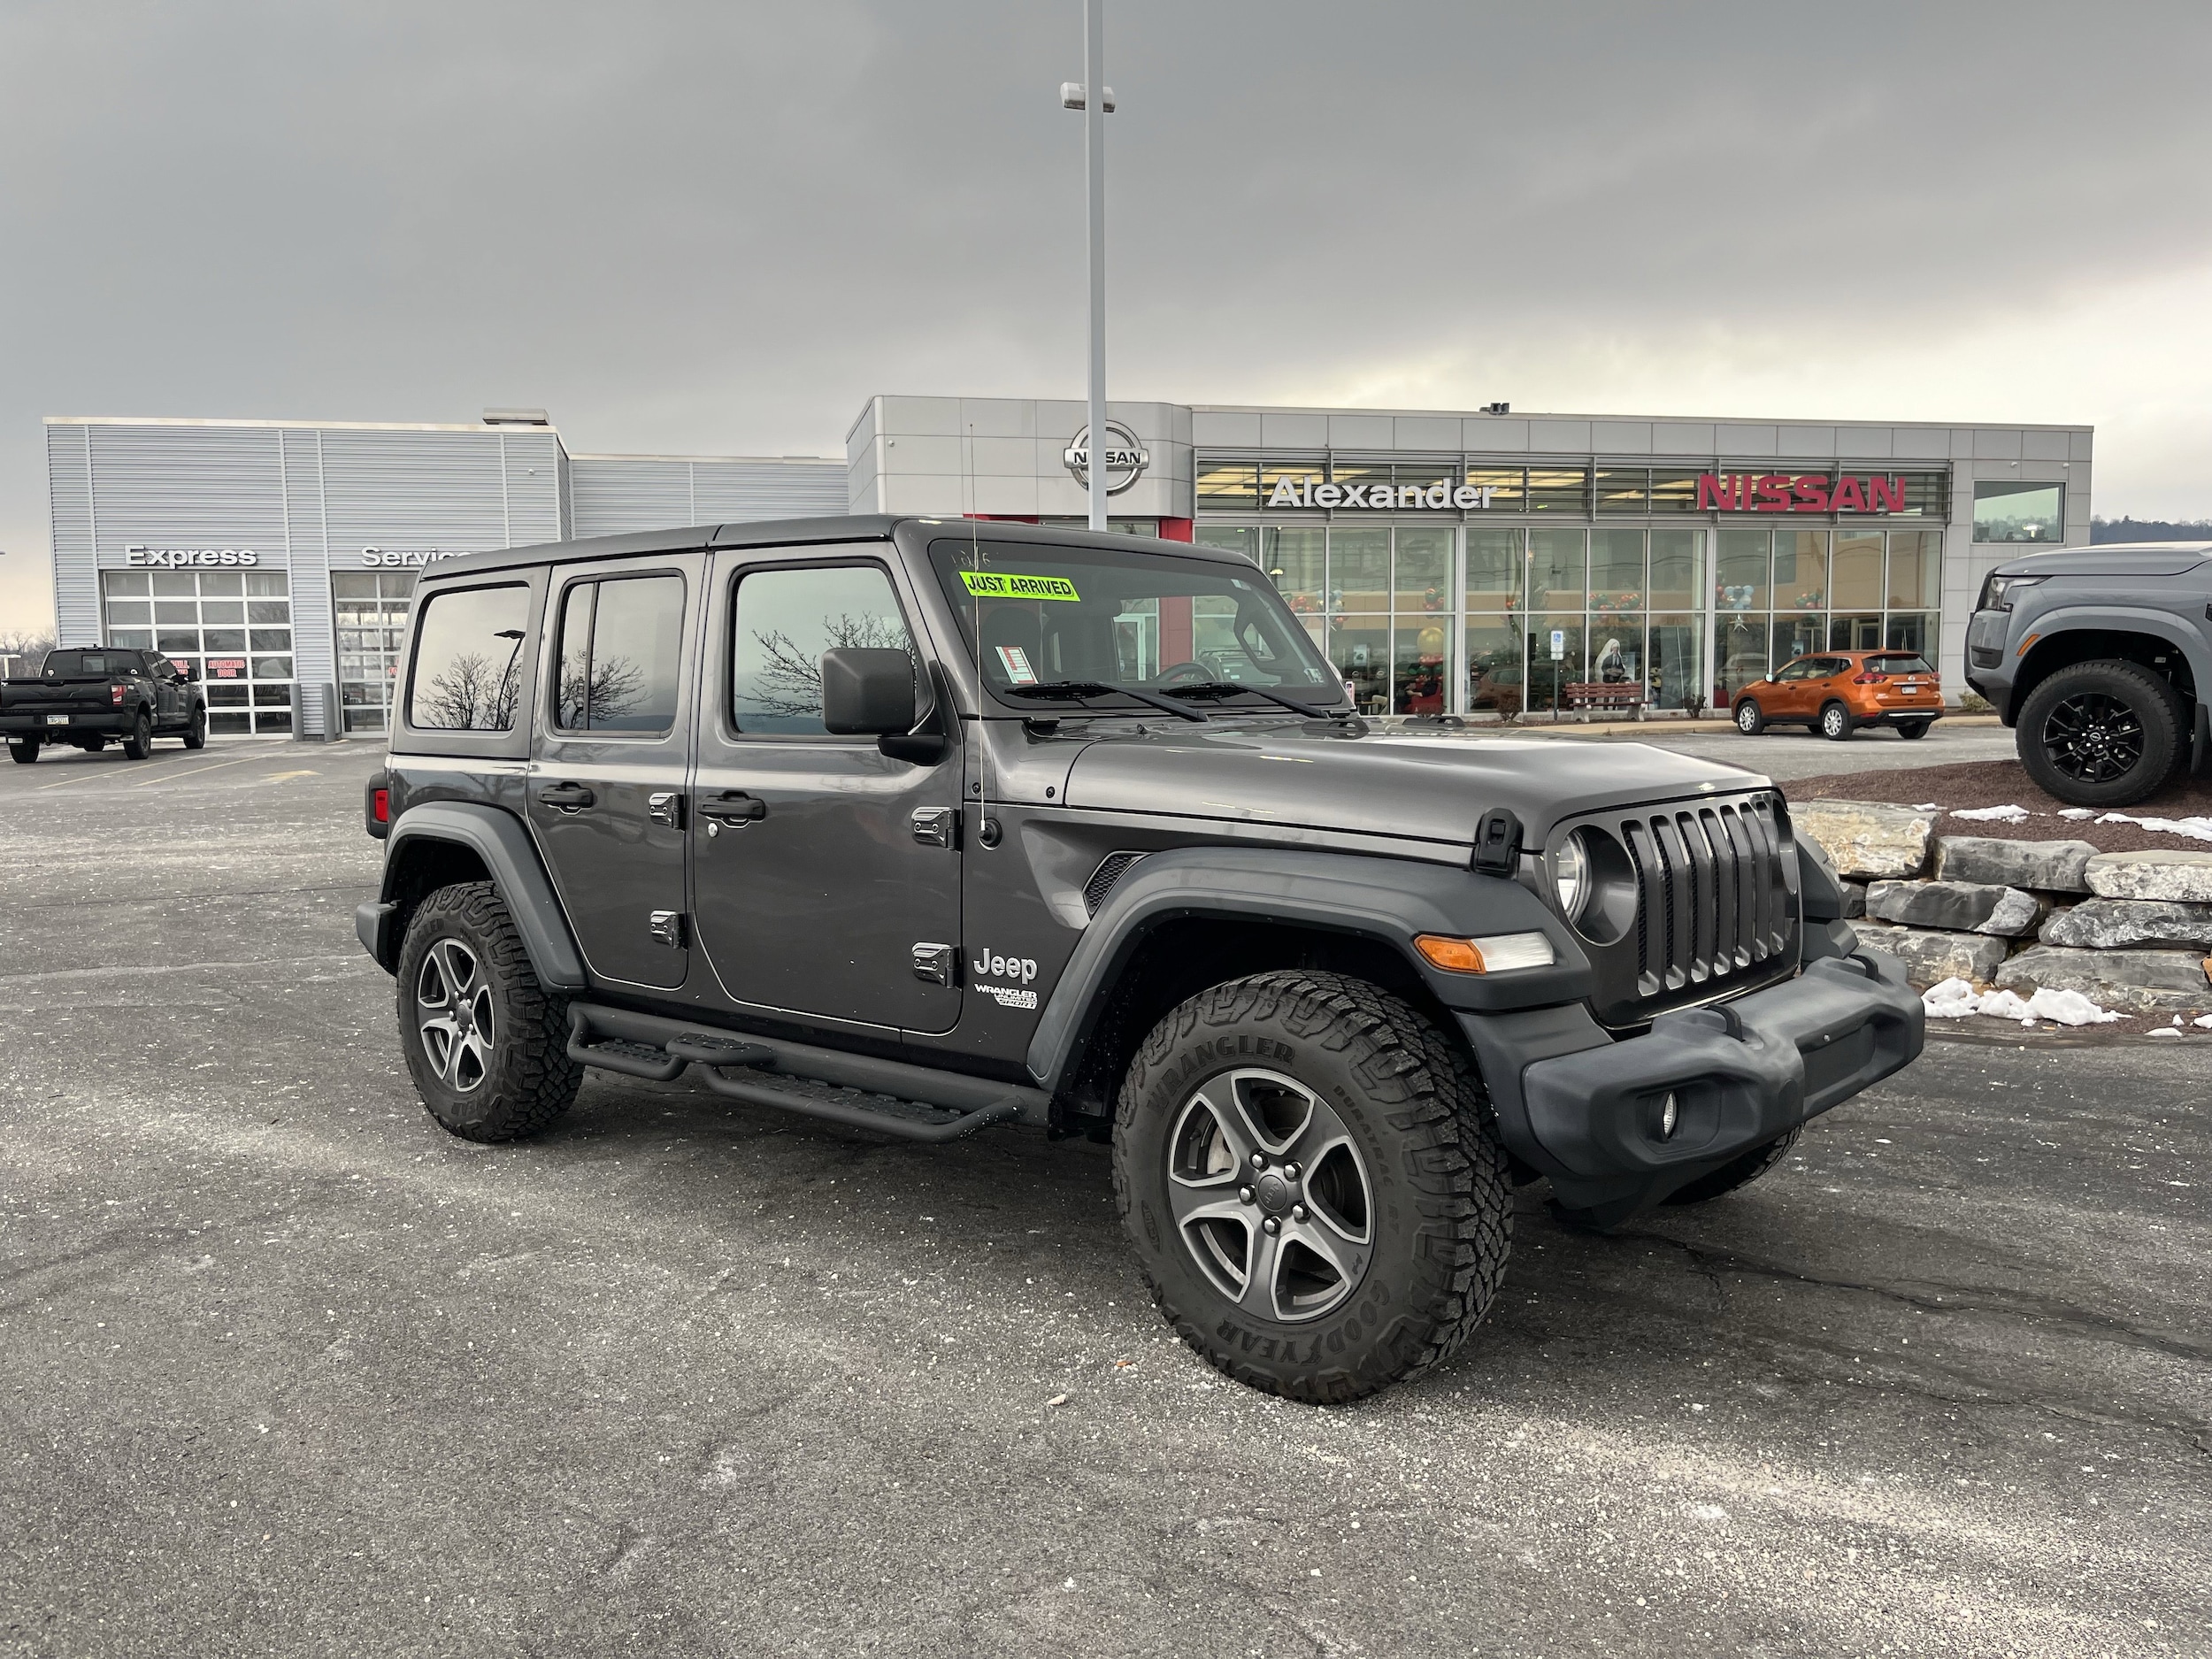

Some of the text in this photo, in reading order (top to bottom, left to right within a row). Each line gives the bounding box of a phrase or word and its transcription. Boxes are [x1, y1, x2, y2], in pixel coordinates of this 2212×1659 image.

[1073, 451, 1141, 465] NSAN
[1267, 473, 1905, 512] Alexander NISSAN
[124, 544, 472, 570] Express Servi
[968, 575, 1073, 597] JUST ARRIVED
[208, 659, 246, 669] AUTOMATIC
[973, 948, 1038, 985] Jeep
[974, 983, 1037, 999] WRANGLER
[995, 993, 1037, 1002] UNLIMITED
[998, 998, 1036, 1009] SPORT
[1147, 1034, 1295, 1116] WRANGLER
[1216, 1279, 1390, 1366] GOODYEAR
